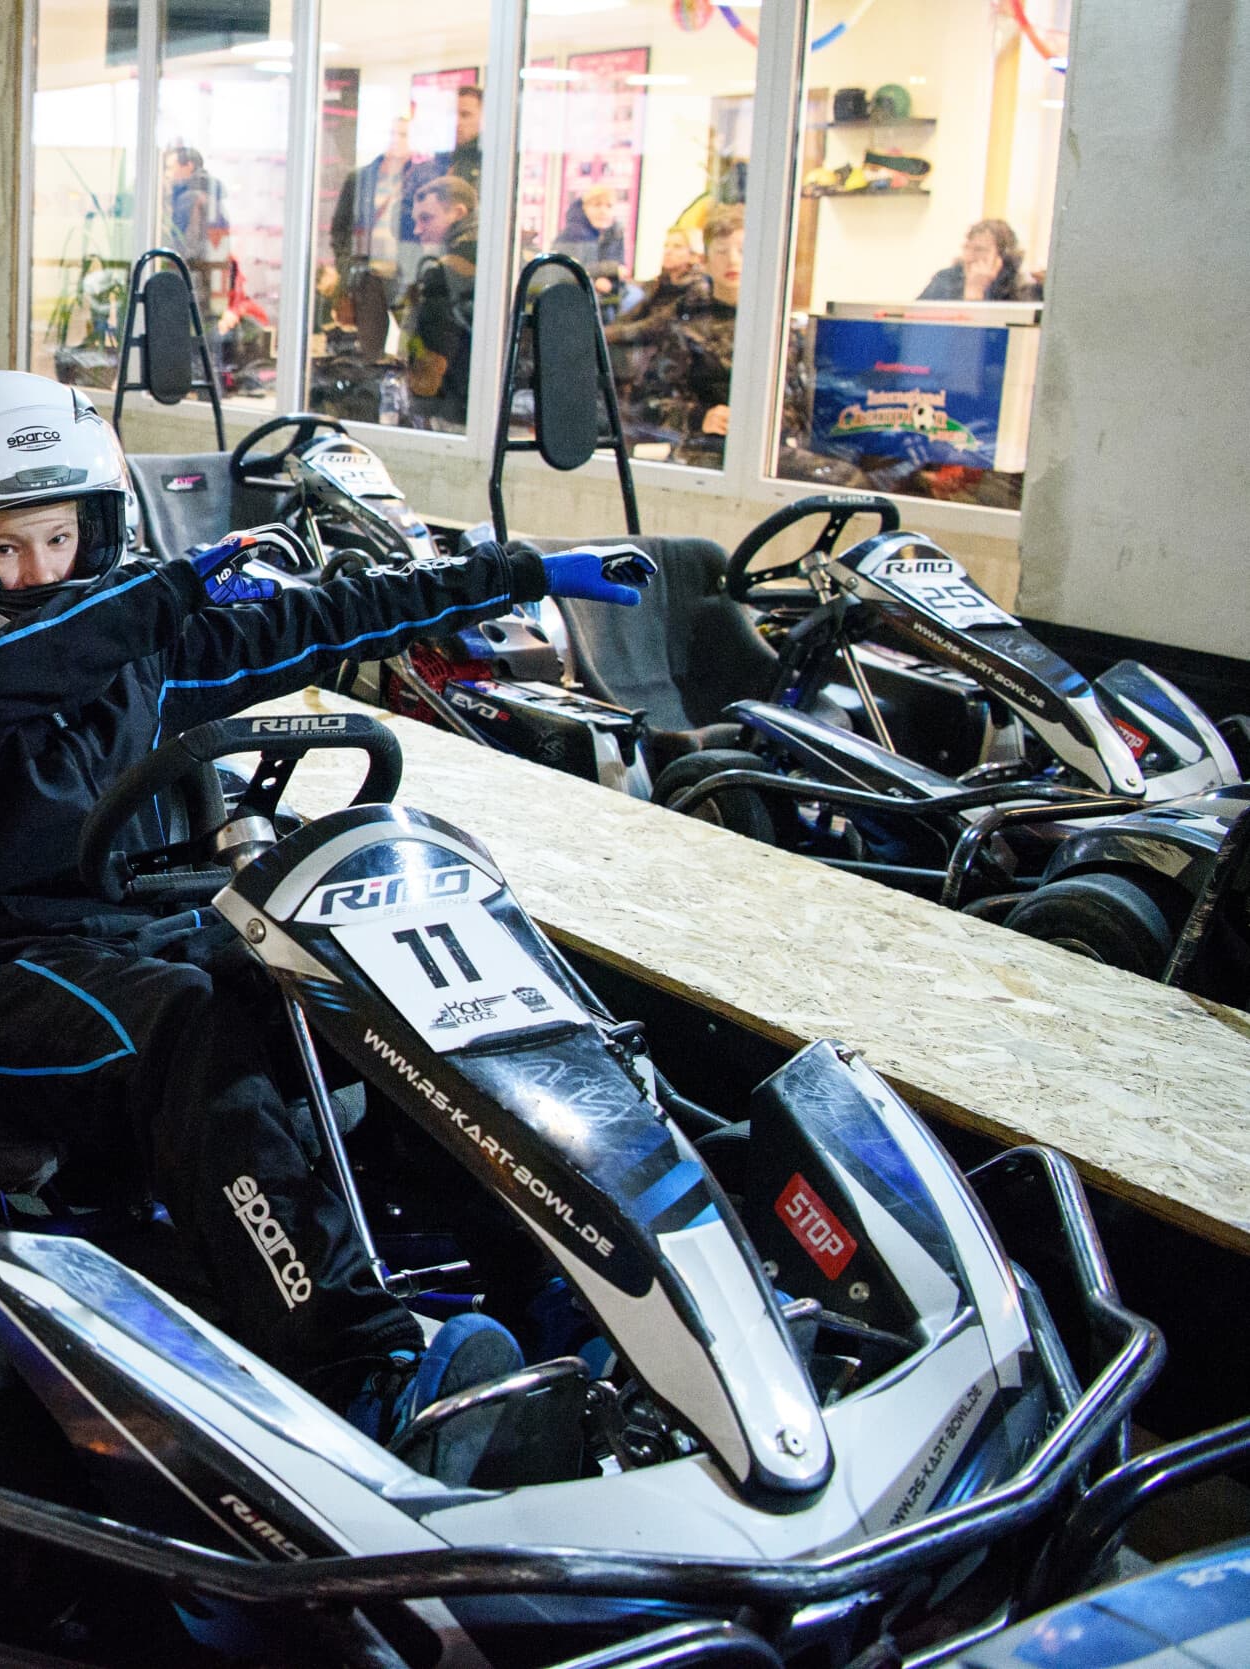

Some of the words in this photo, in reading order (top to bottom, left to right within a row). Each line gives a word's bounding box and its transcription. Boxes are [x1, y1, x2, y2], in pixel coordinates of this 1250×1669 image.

[7, 431, 60, 447] sparco
[921, 586, 985, 609] 25
[391, 922, 483, 989] 11
[363, 1028, 616, 1258] WWW.RS-KART-BOWL.DE
[232, 1174, 313, 1304] sparco
[785, 1191, 845, 1257] STOP
